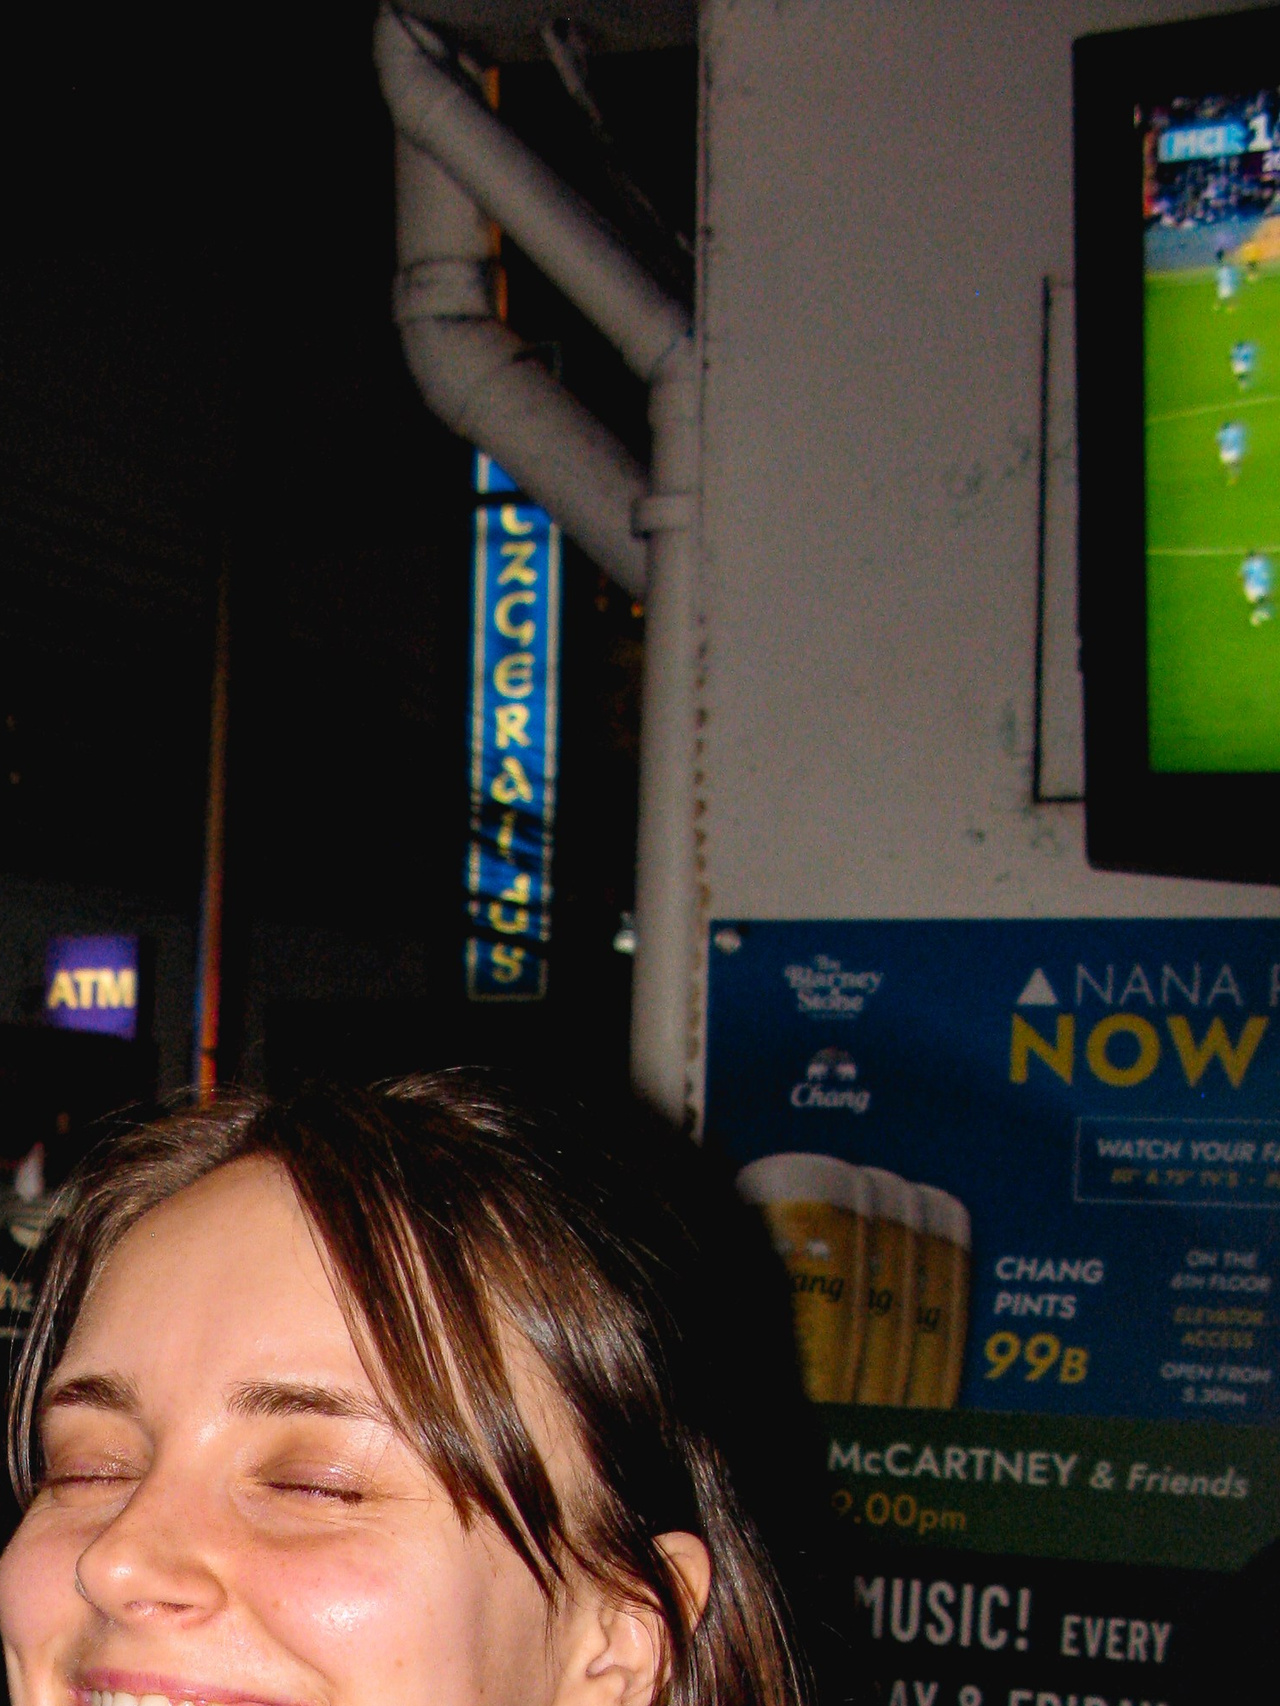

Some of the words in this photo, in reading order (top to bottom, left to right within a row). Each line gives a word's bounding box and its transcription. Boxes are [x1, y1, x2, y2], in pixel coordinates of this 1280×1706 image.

[47, 968, 138, 1009] ATM
[1076, 963, 1243, 1006] NANA
[1010, 1012, 1268, 1088] NOW
[1097, 1138, 1183, 1161] WATCH
[1190, 1140, 1256, 1163] YOUR
[995, 1256, 1104, 1284] CHANG
[993, 1291, 1077, 1319] PINTS
[984, 1330, 1089, 1384] 99B
[827, 1440, 1080, 1487] McCARTNEY
[1089, 1459, 1116, 1491] &
[1126, 1461, 1250, 1500] Friends
[854, 1575, 1032, 1652] MUSIC!
[1059, 1613, 1172, 1664] EVERY
